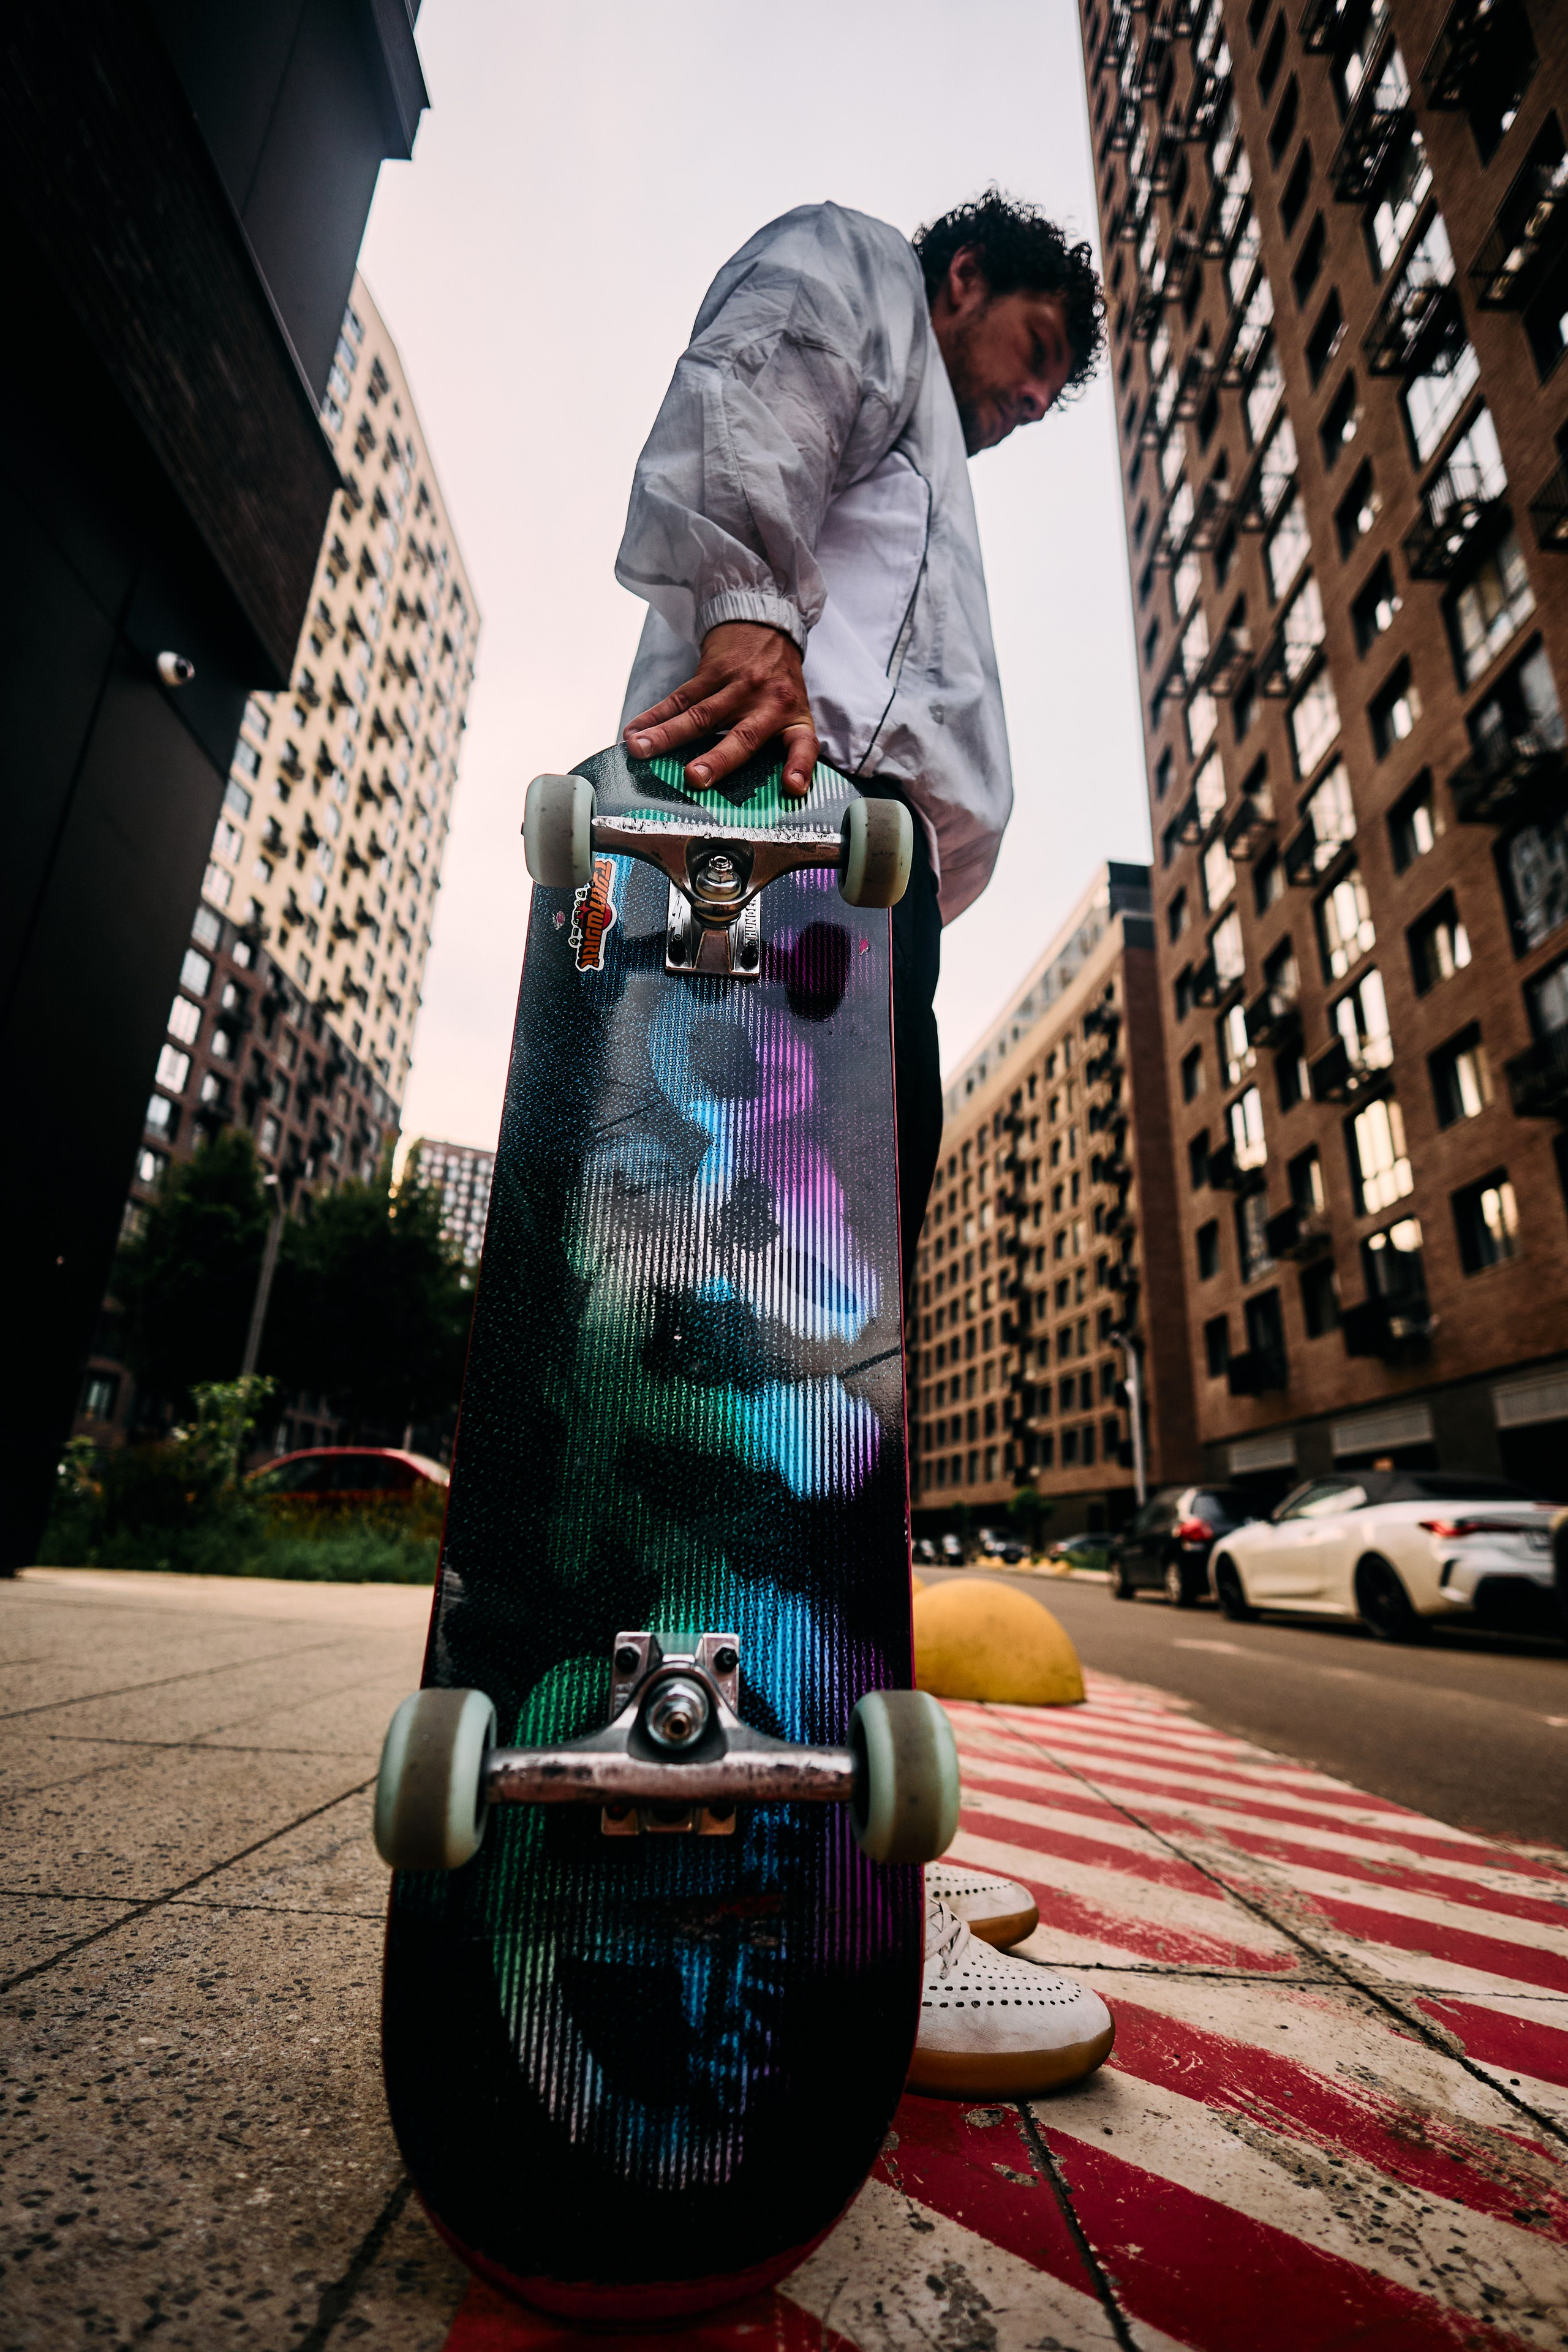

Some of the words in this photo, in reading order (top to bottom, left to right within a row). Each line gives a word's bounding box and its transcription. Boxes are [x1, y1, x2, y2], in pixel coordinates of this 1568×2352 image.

[570, 890, 586, 945] フットワーク
[744, 899, 757, 946] THUNDE
